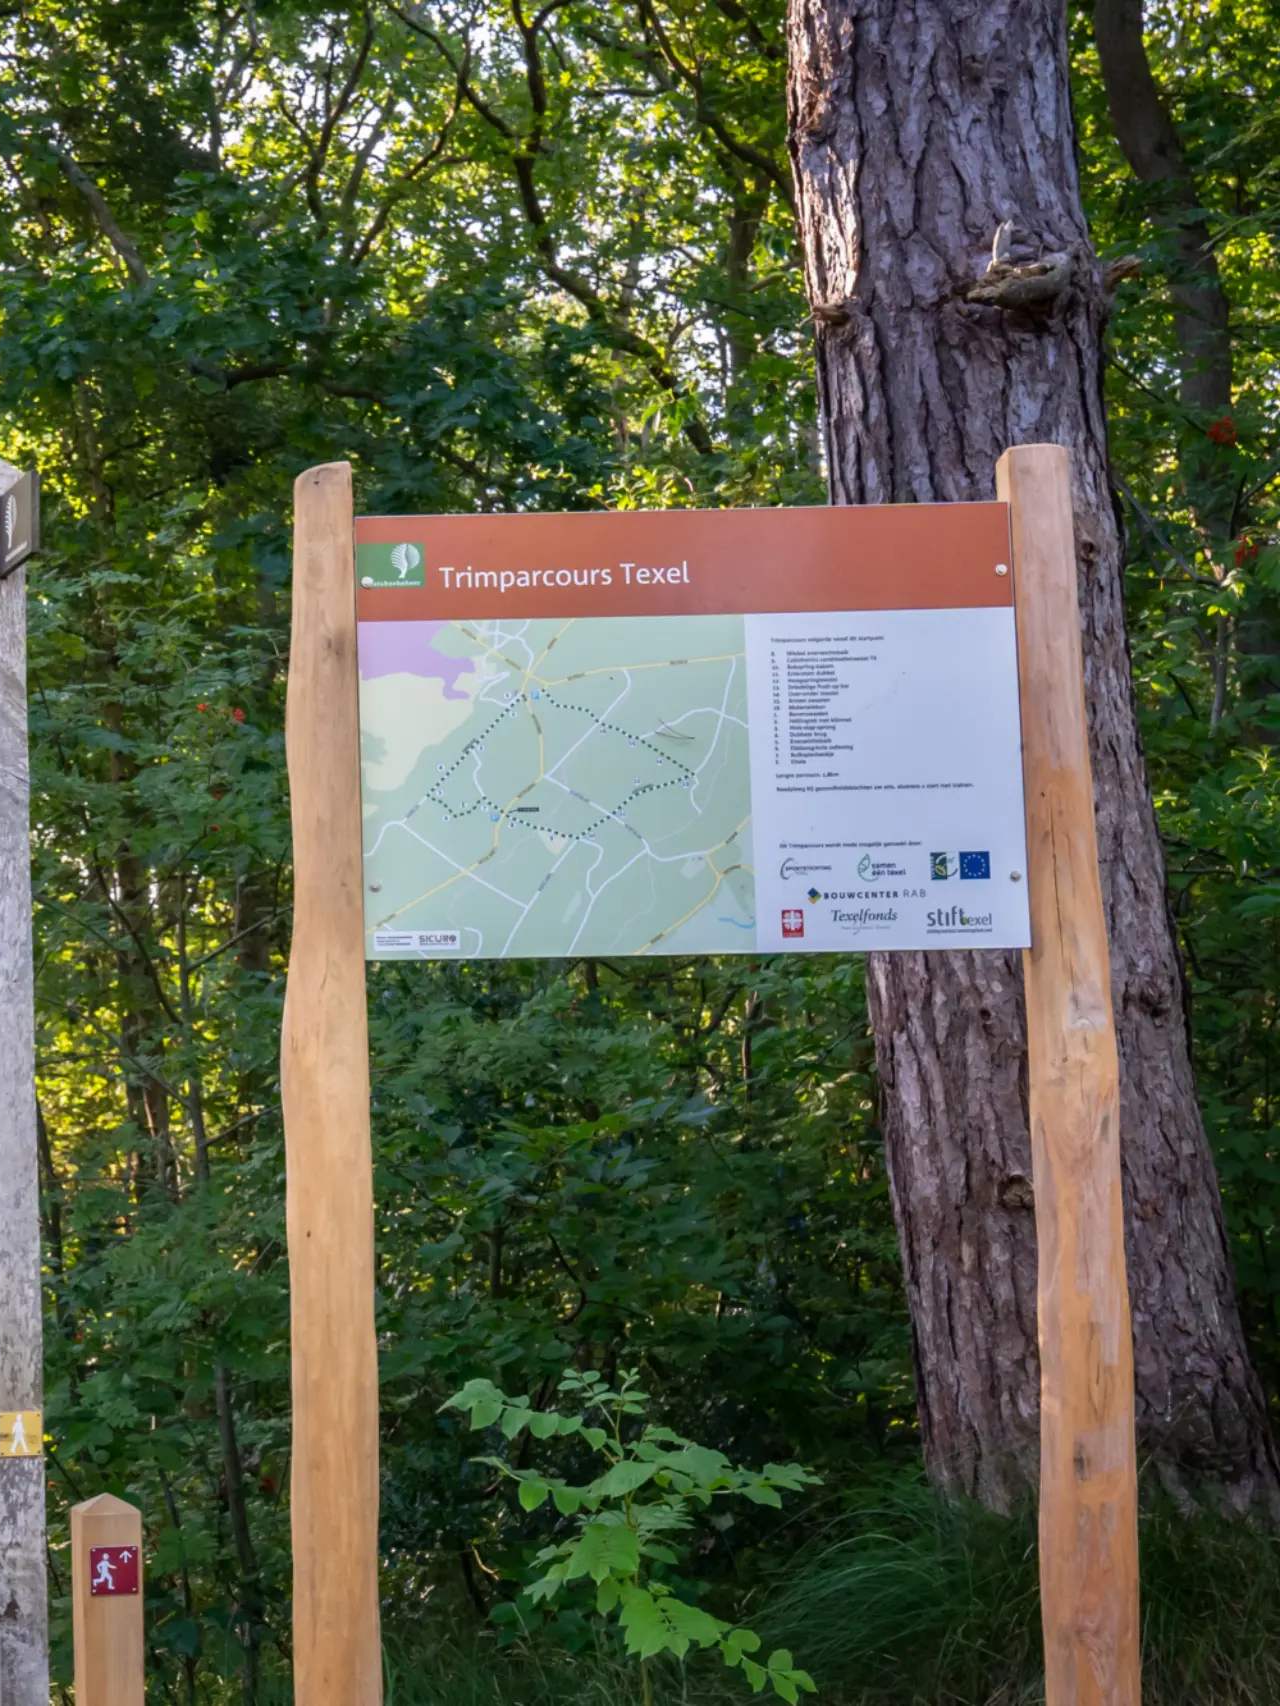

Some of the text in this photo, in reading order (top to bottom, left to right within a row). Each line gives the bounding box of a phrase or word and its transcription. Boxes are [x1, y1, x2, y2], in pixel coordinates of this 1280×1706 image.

[439, 560, 690, 593] Trimparcours Texel
[823, 888, 927, 900] BOUWCENTER RAB
[831, 908, 898, 924] Texelfonds
